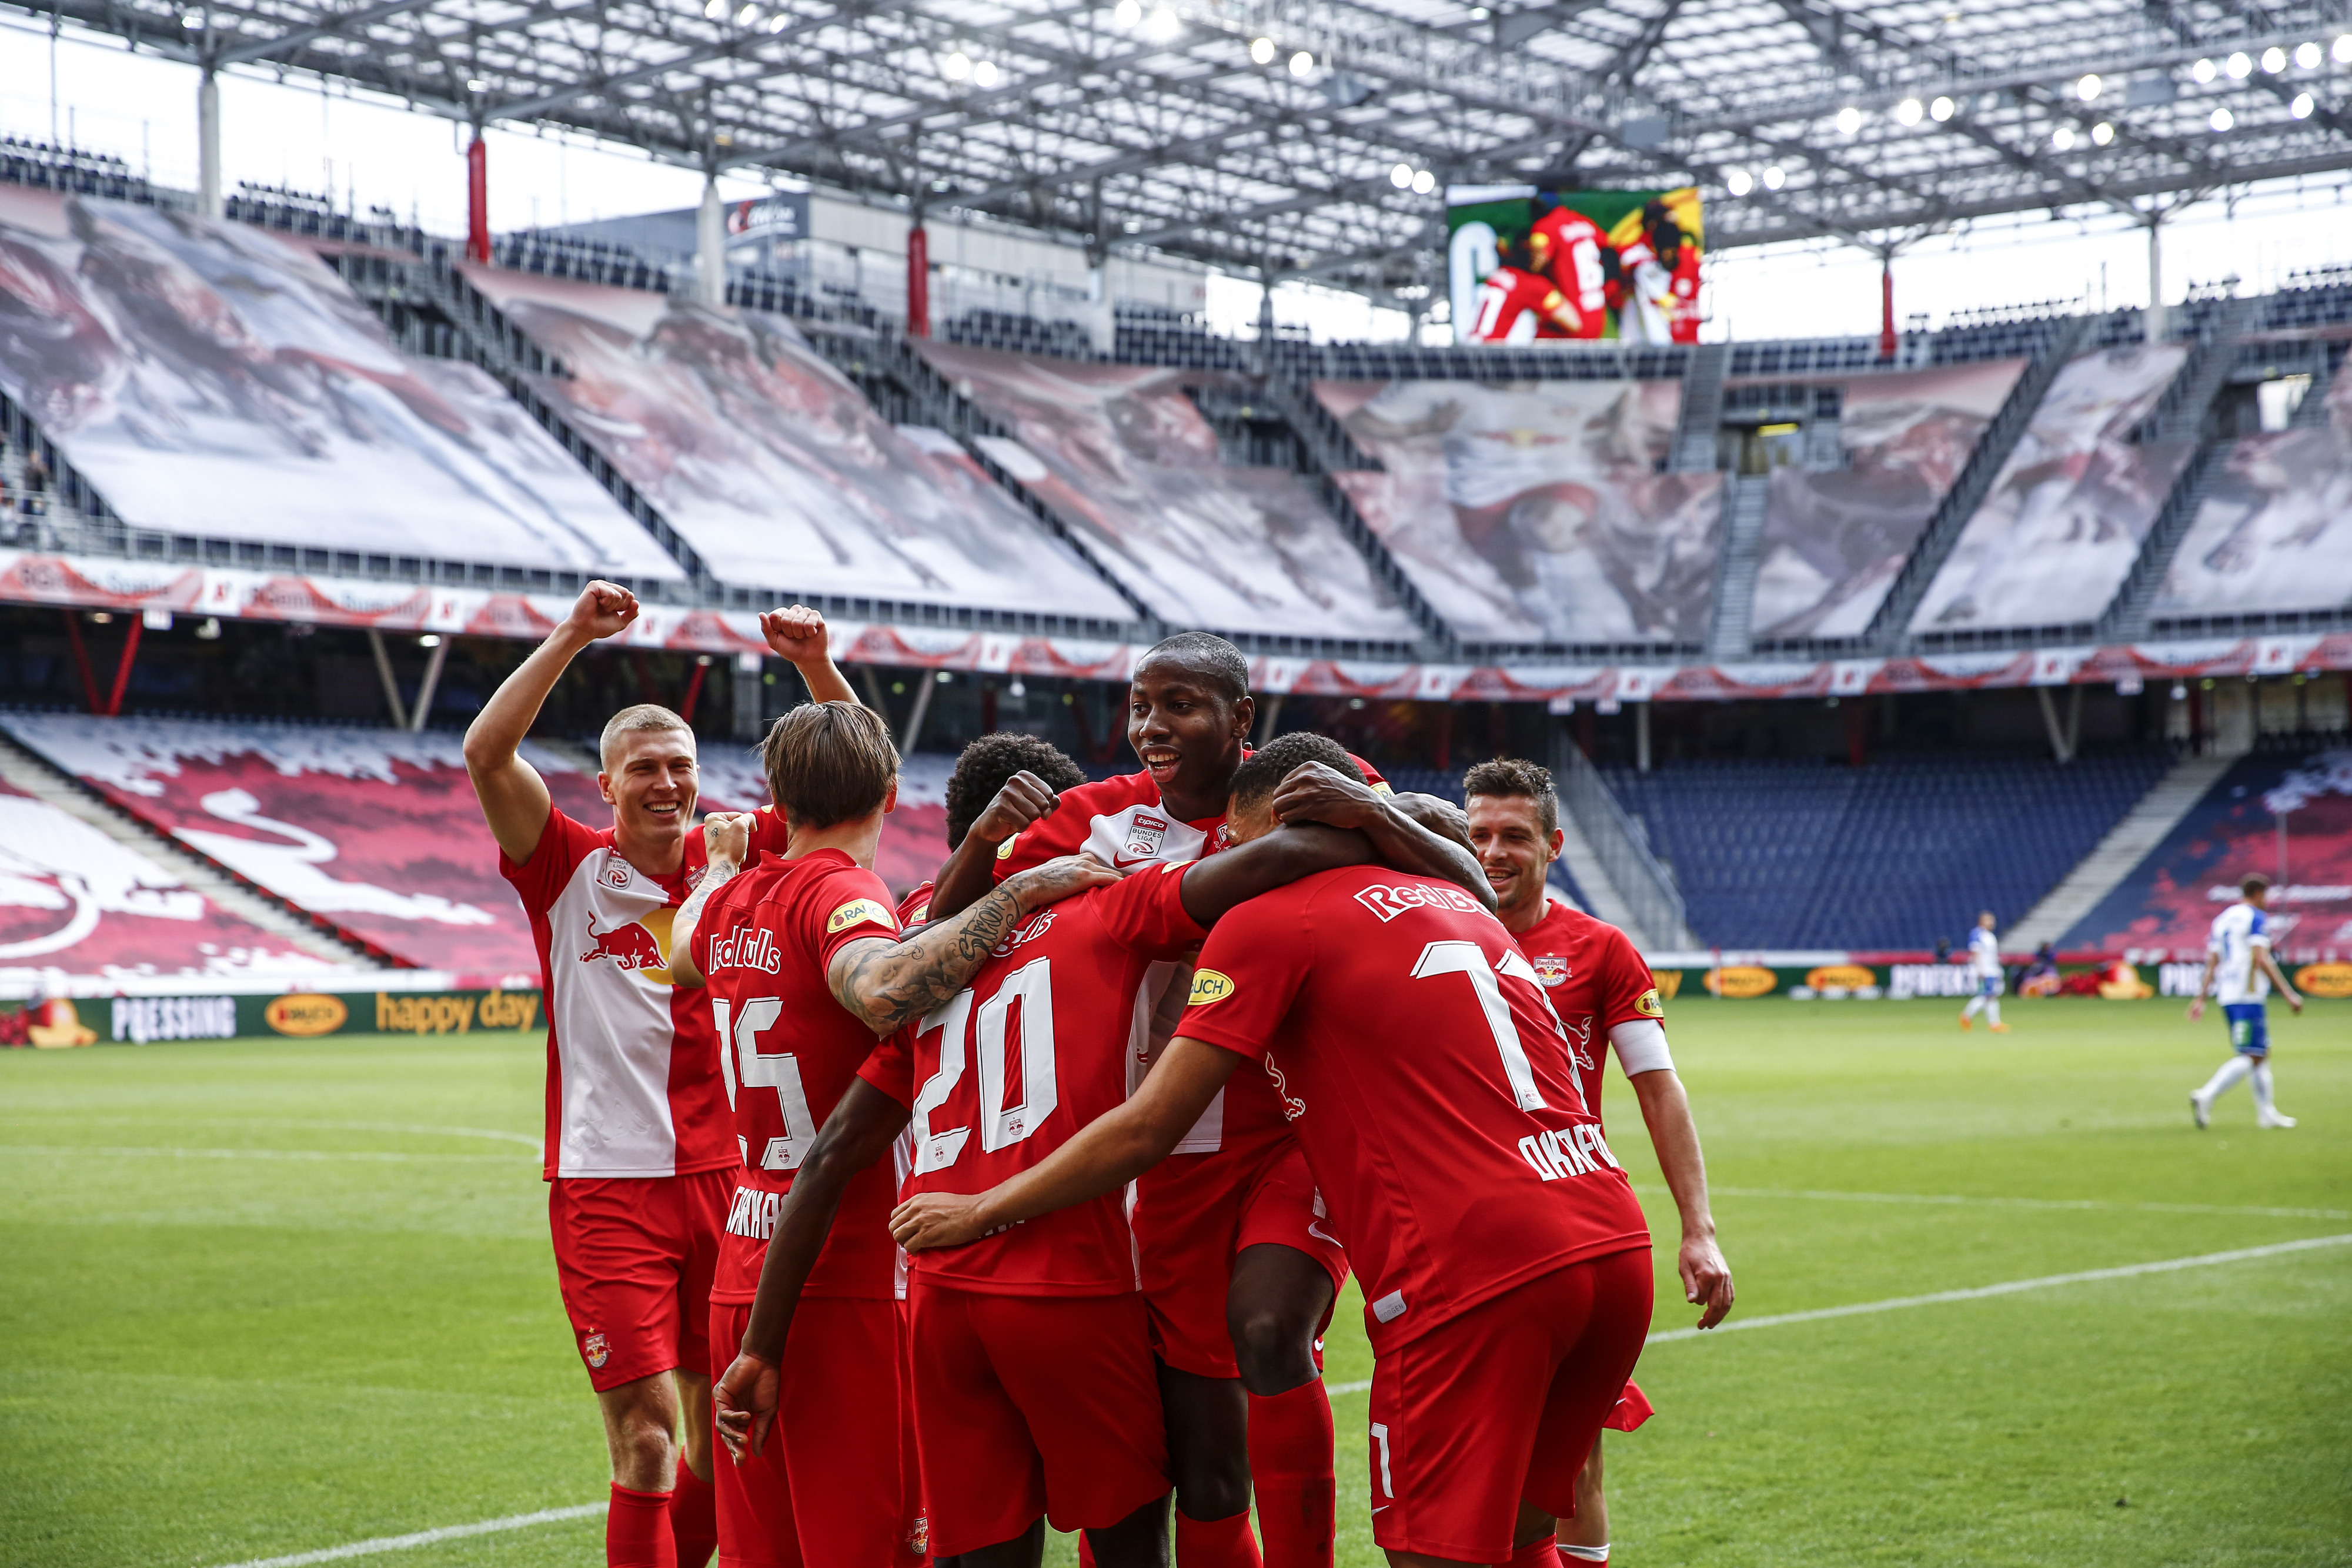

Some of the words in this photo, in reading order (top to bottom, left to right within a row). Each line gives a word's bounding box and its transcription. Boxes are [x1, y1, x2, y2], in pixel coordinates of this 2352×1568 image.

[1137, 817, 1164, 828] tipico
[1132, 828, 1162, 838] BUNDES
[844, 904, 890, 924] RAUCH
[376, 992, 475, 1036] happy
[479, 988, 539, 1033] day
[912, 955, 1058, 1178] 20
